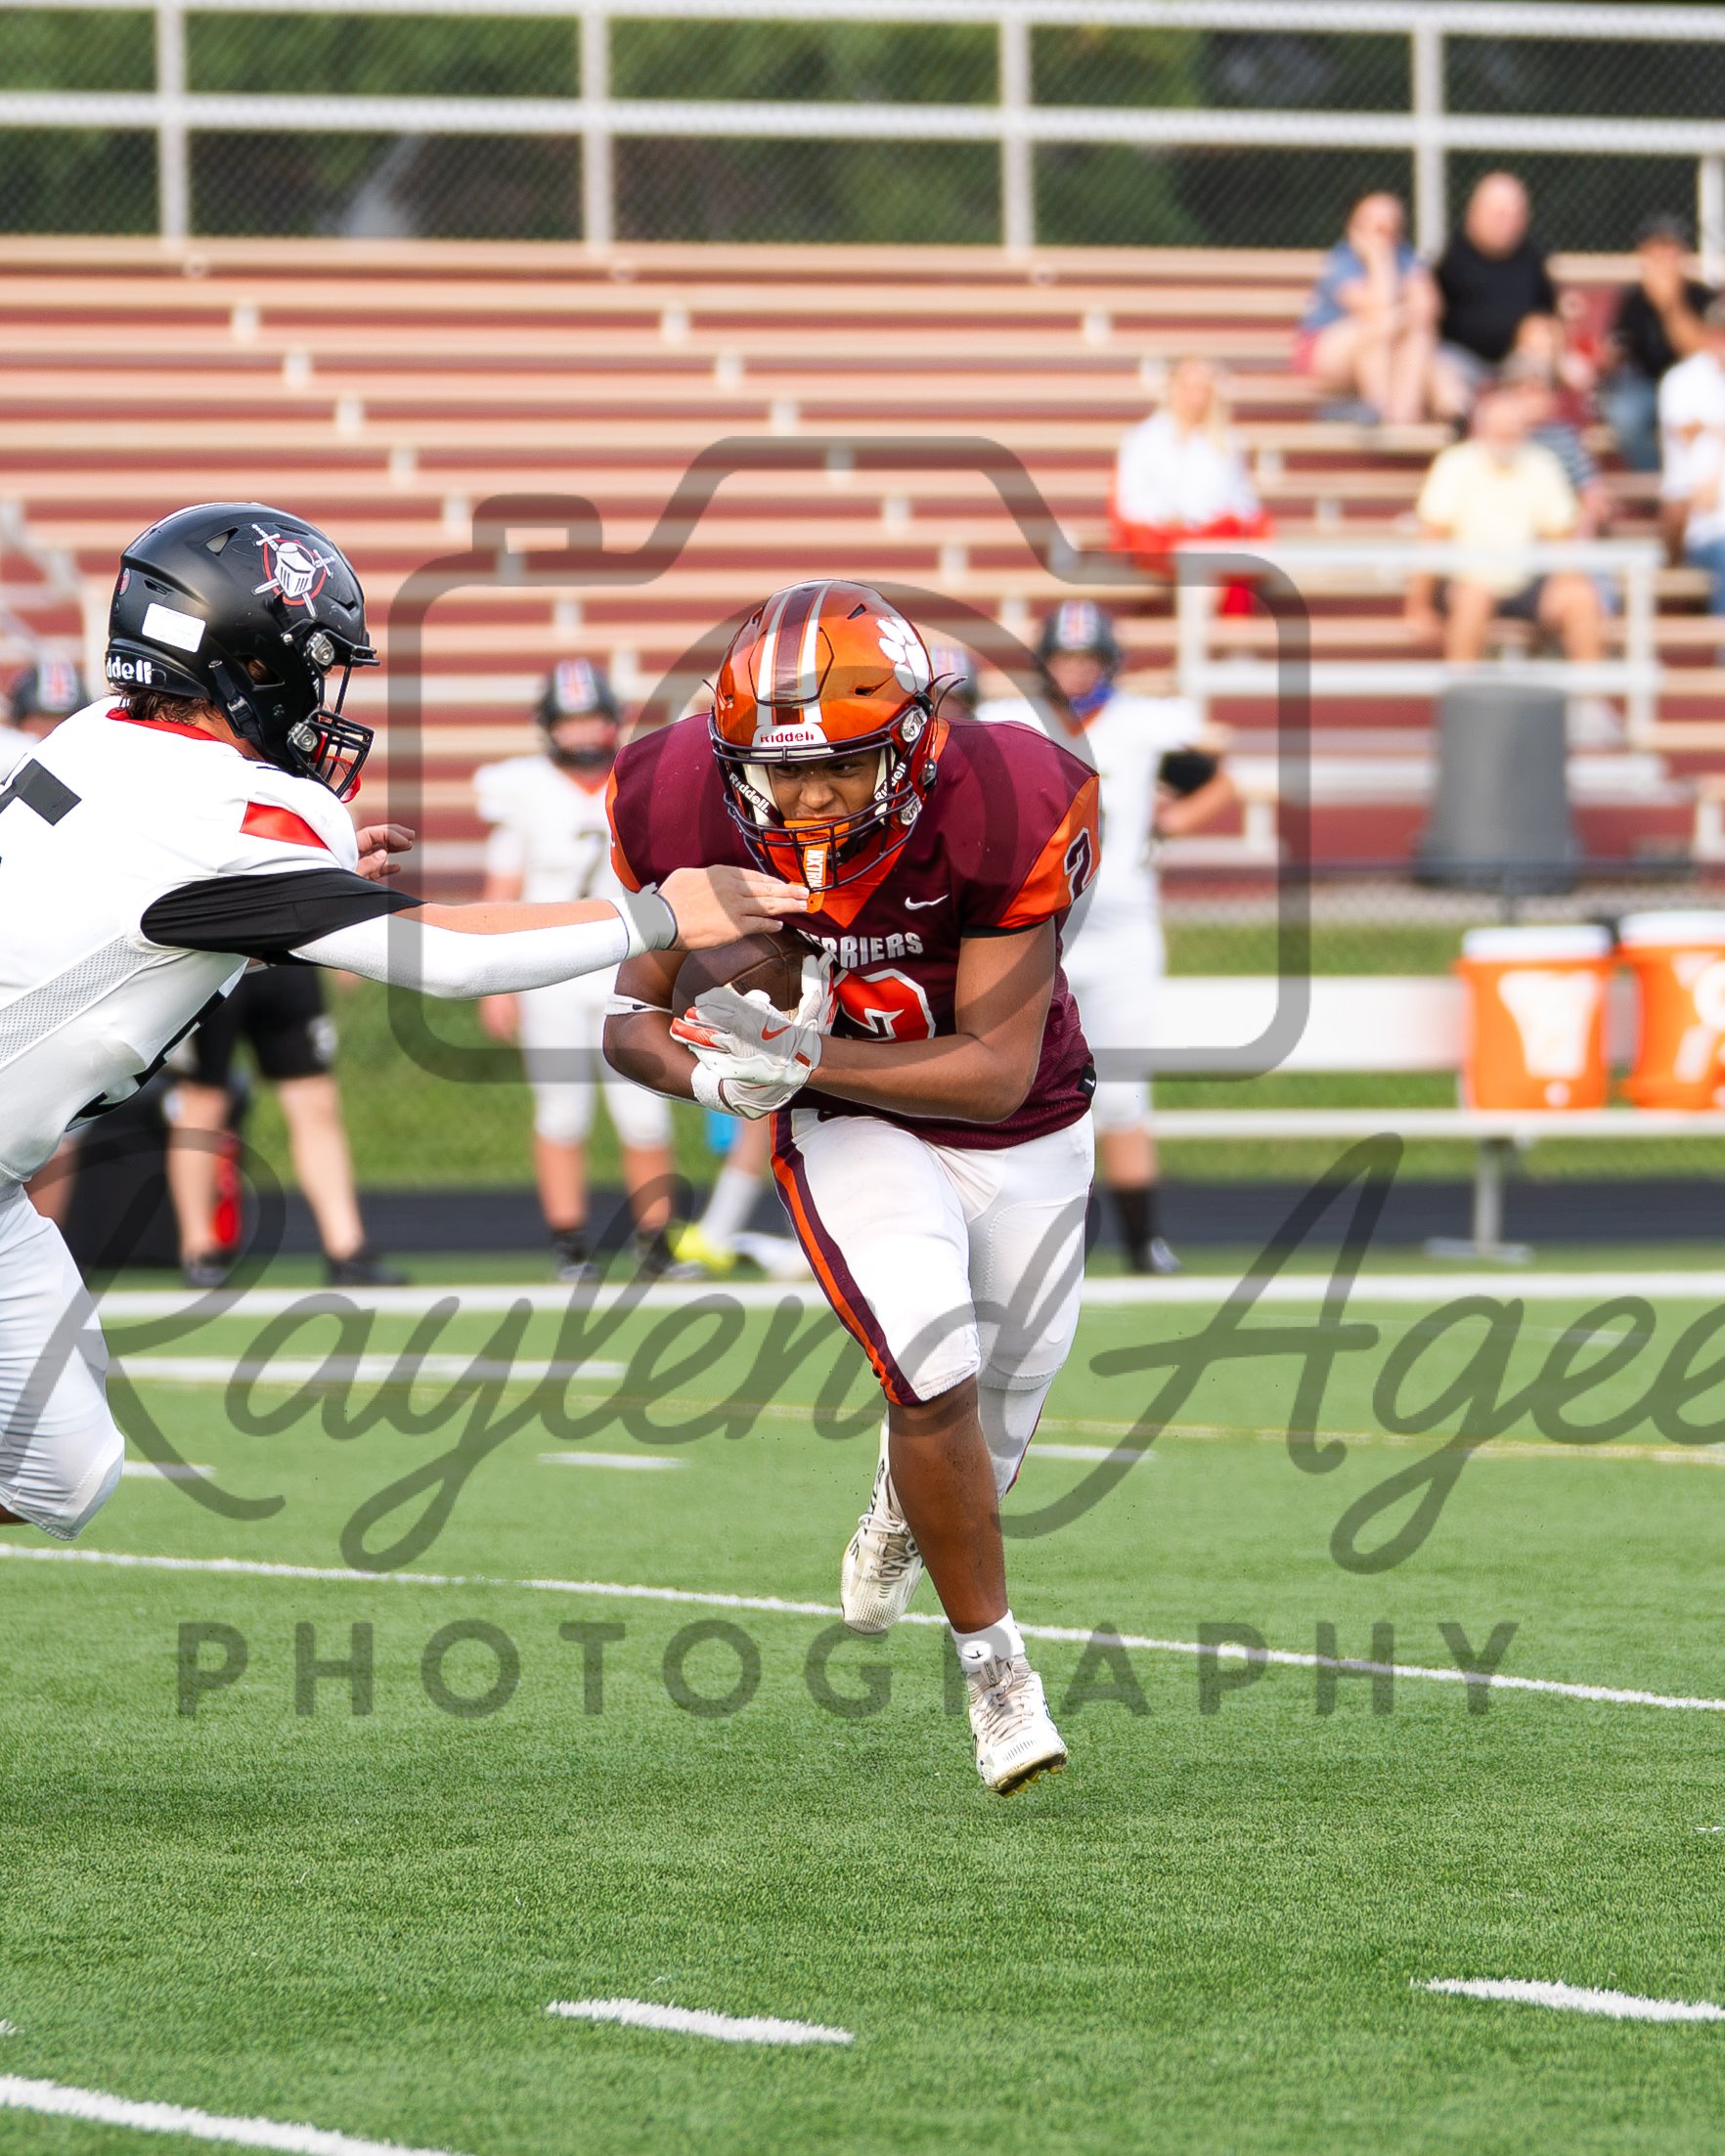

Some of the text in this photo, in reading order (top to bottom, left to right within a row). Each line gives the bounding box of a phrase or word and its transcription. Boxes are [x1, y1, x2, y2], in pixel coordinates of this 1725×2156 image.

[106, 655, 153, 684] ddell
[760, 730, 815, 743] Riddell
[806, 849, 824, 895] NXTRN
[797, 928, 924, 969] RRIERS
